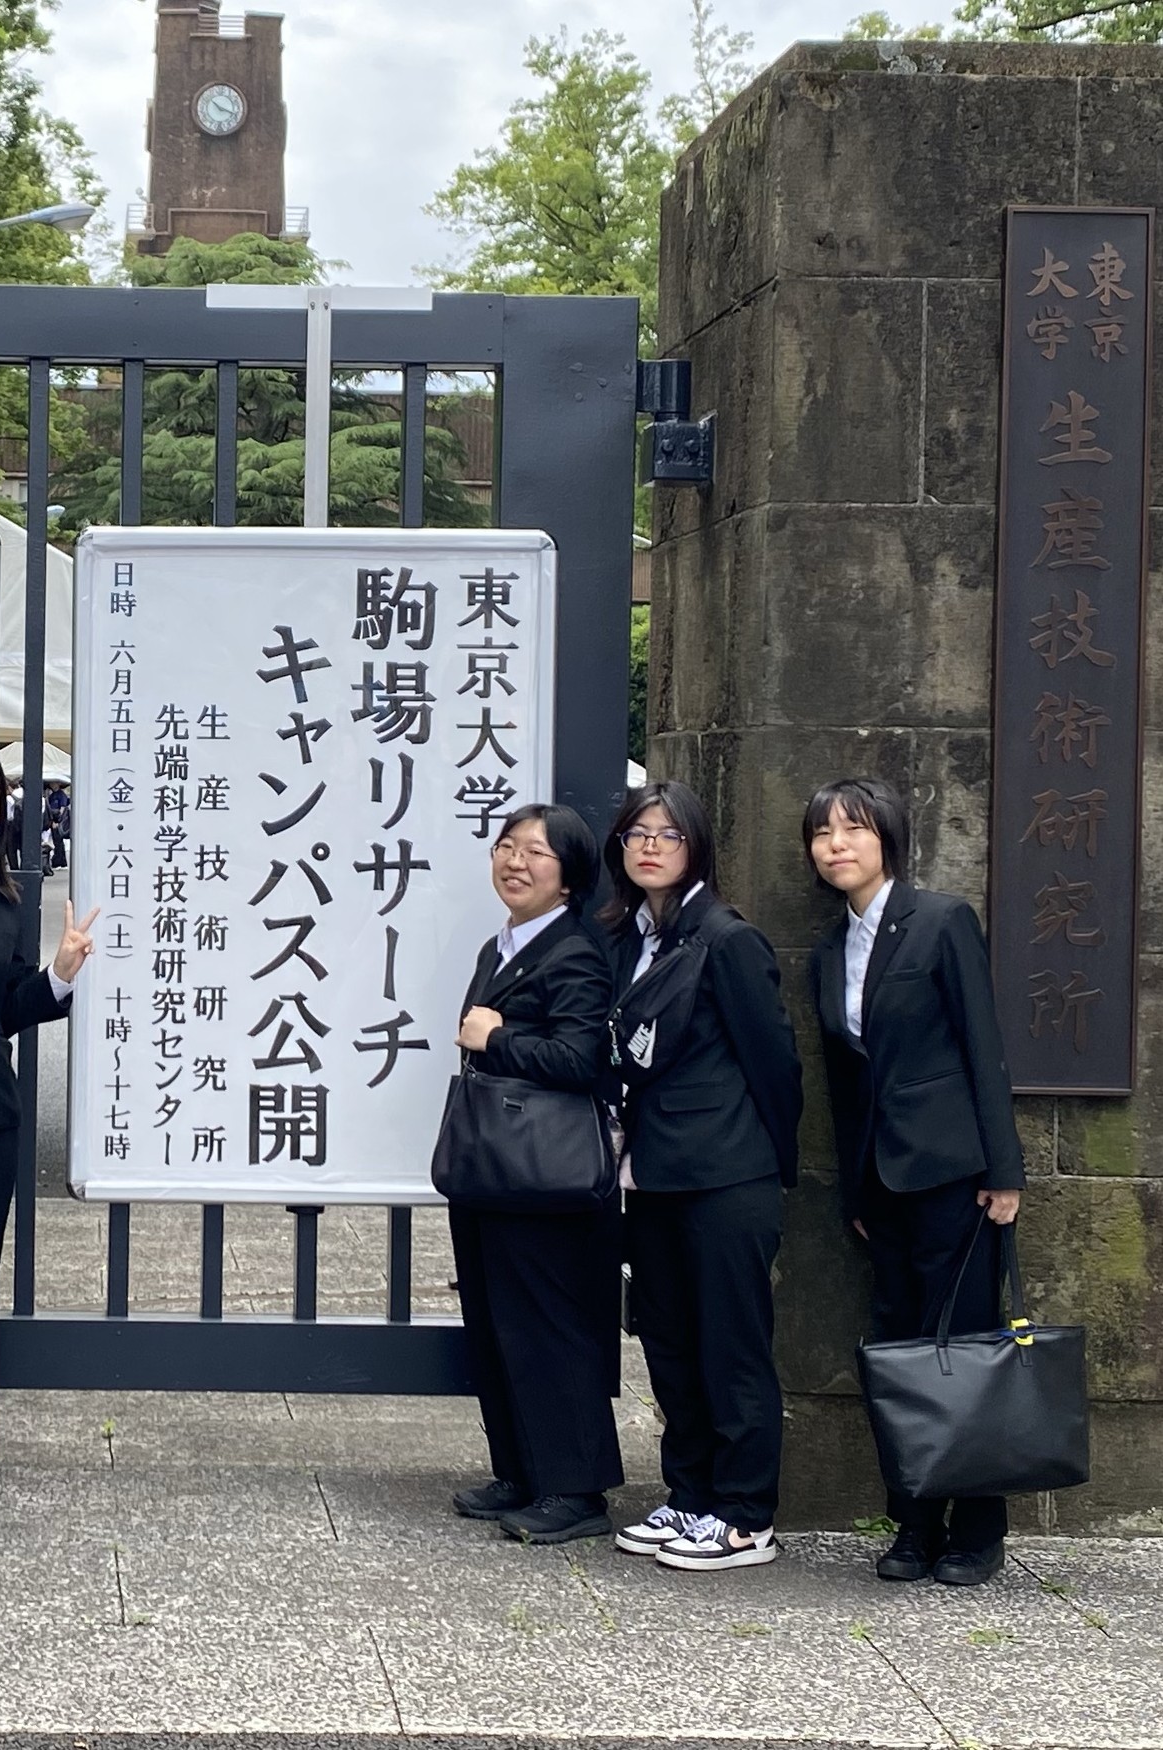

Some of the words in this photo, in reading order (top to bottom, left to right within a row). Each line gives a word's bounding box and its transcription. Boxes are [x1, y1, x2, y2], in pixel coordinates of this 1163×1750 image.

[1025, 247, 1080, 361] 大学
[1082, 241, 1134, 364] 東京
[110, 562, 137, 617] 日時
[454, 567, 520, 838] 東京大学
[1019, 390, 1118, 1054] 生産技術研究所
[151, 703, 189, 1166] 先端科学技術研究センター
[191, 704, 231, 1163] 生産技術研究所
[248, 625, 333, 1167] キャンパス公開
[350, 567, 438, 1089] 駒場リサーチ
